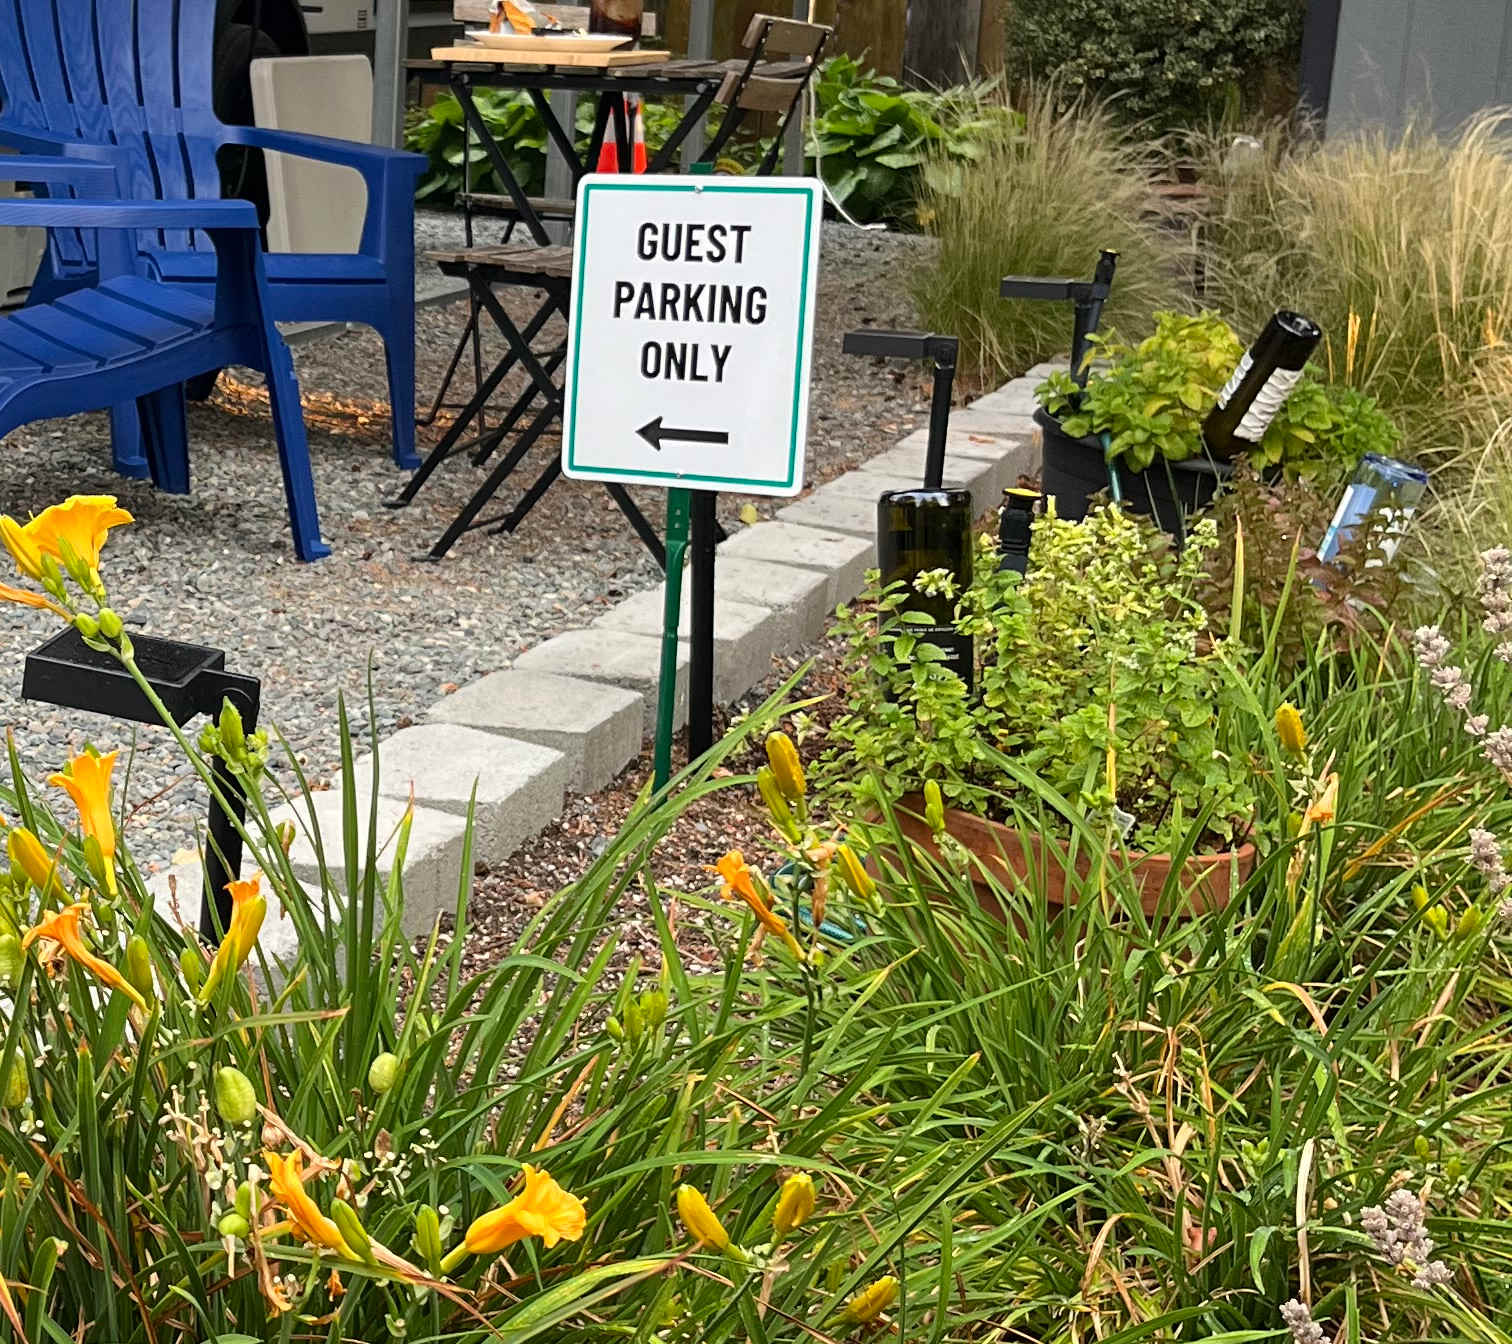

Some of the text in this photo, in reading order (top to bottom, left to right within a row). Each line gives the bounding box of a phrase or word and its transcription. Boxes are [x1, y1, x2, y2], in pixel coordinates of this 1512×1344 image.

[638, 222, 752, 264] GUEST
[612, 280, 768, 325] PARKING
[640, 340, 732, 383] ONLY
